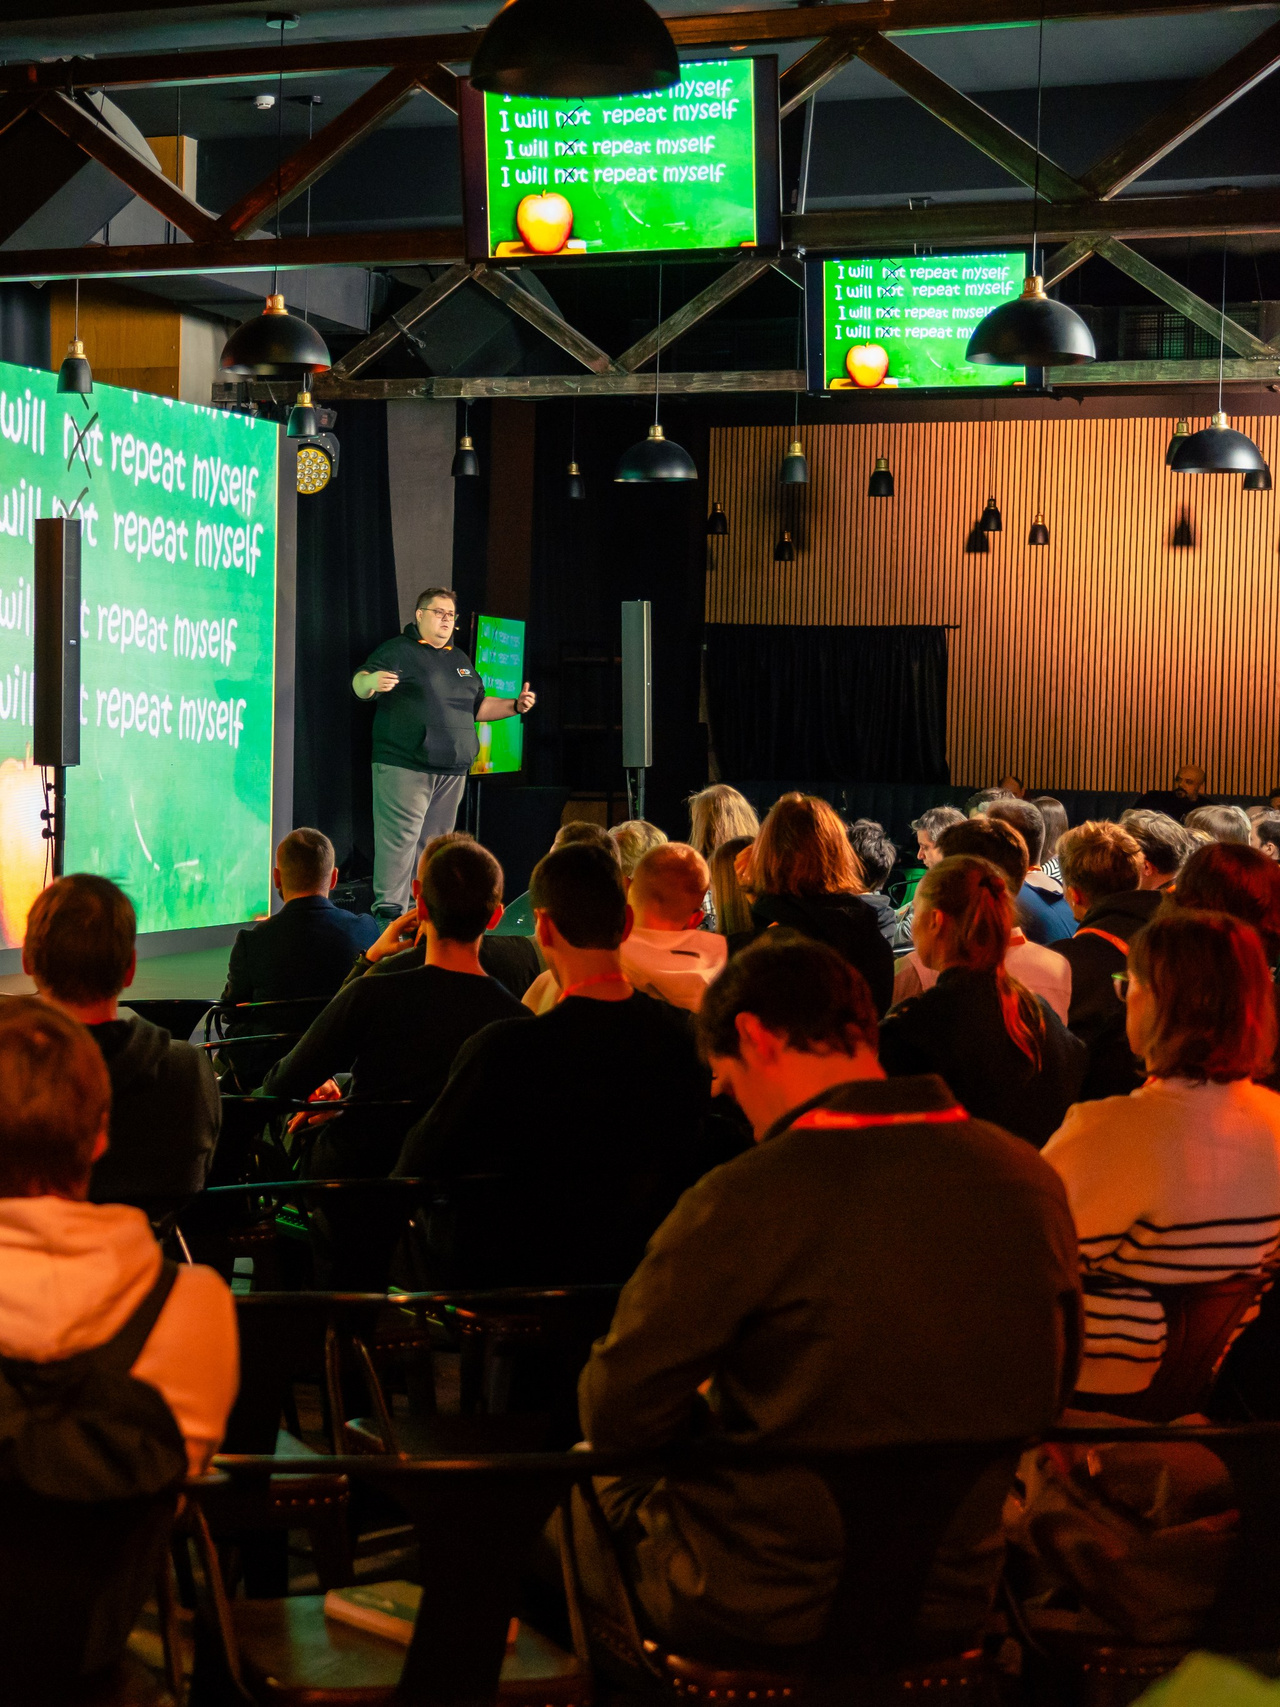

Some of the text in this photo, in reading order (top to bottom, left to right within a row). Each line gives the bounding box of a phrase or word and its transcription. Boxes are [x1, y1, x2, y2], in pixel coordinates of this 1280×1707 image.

[668, 79, 733, 99] myself
[499, 110, 510, 132] I
[514, 109, 548, 130] will
[602, 107, 667, 127] repeat
[673, 99, 739, 122] myself
[504, 139, 516, 160] I
[518, 138, 548, 158] will
[592, 139, 652, 158] repeat
[656, 135, 716, 155] myself
[500, 166, 511, 188] I
[515, 165, 548, 185] will
[594, 166, 658, 185] repeat
[663, 163, 726, 183] myself
[837, 265, 845, 280] I
[848, 264, 873, 279] will
[909, 267, 958, 281] repeat
[962, 266, 1010, 281] myself
[834, 284, 842, 301] I
[846, 284, 872, 299] will
[912, 284, 961, 298] repeat
[965, 281, 1015, 297] myself
[838, 305, 847, 321] I
[848, 305, 871, 320] will
[904, 307, 949, 320] repeat
[834, 324, 842, 340] I
[845, 324, 871, 339] will
[904, 327, 954, 340] repeat
[0, 388, 46, 456] will
[111, 432, 187, 493] repeat
[192, 454, 259, 517] myself
[113, 511, 189, 563] repeat
[195, 520, 264, 577] myself
[97, 604, 168, 655] repeat
[173, 614, 238, 667] myself
[96, 687, 173, 739] repeat
[178, 696, 247, 749] myself
